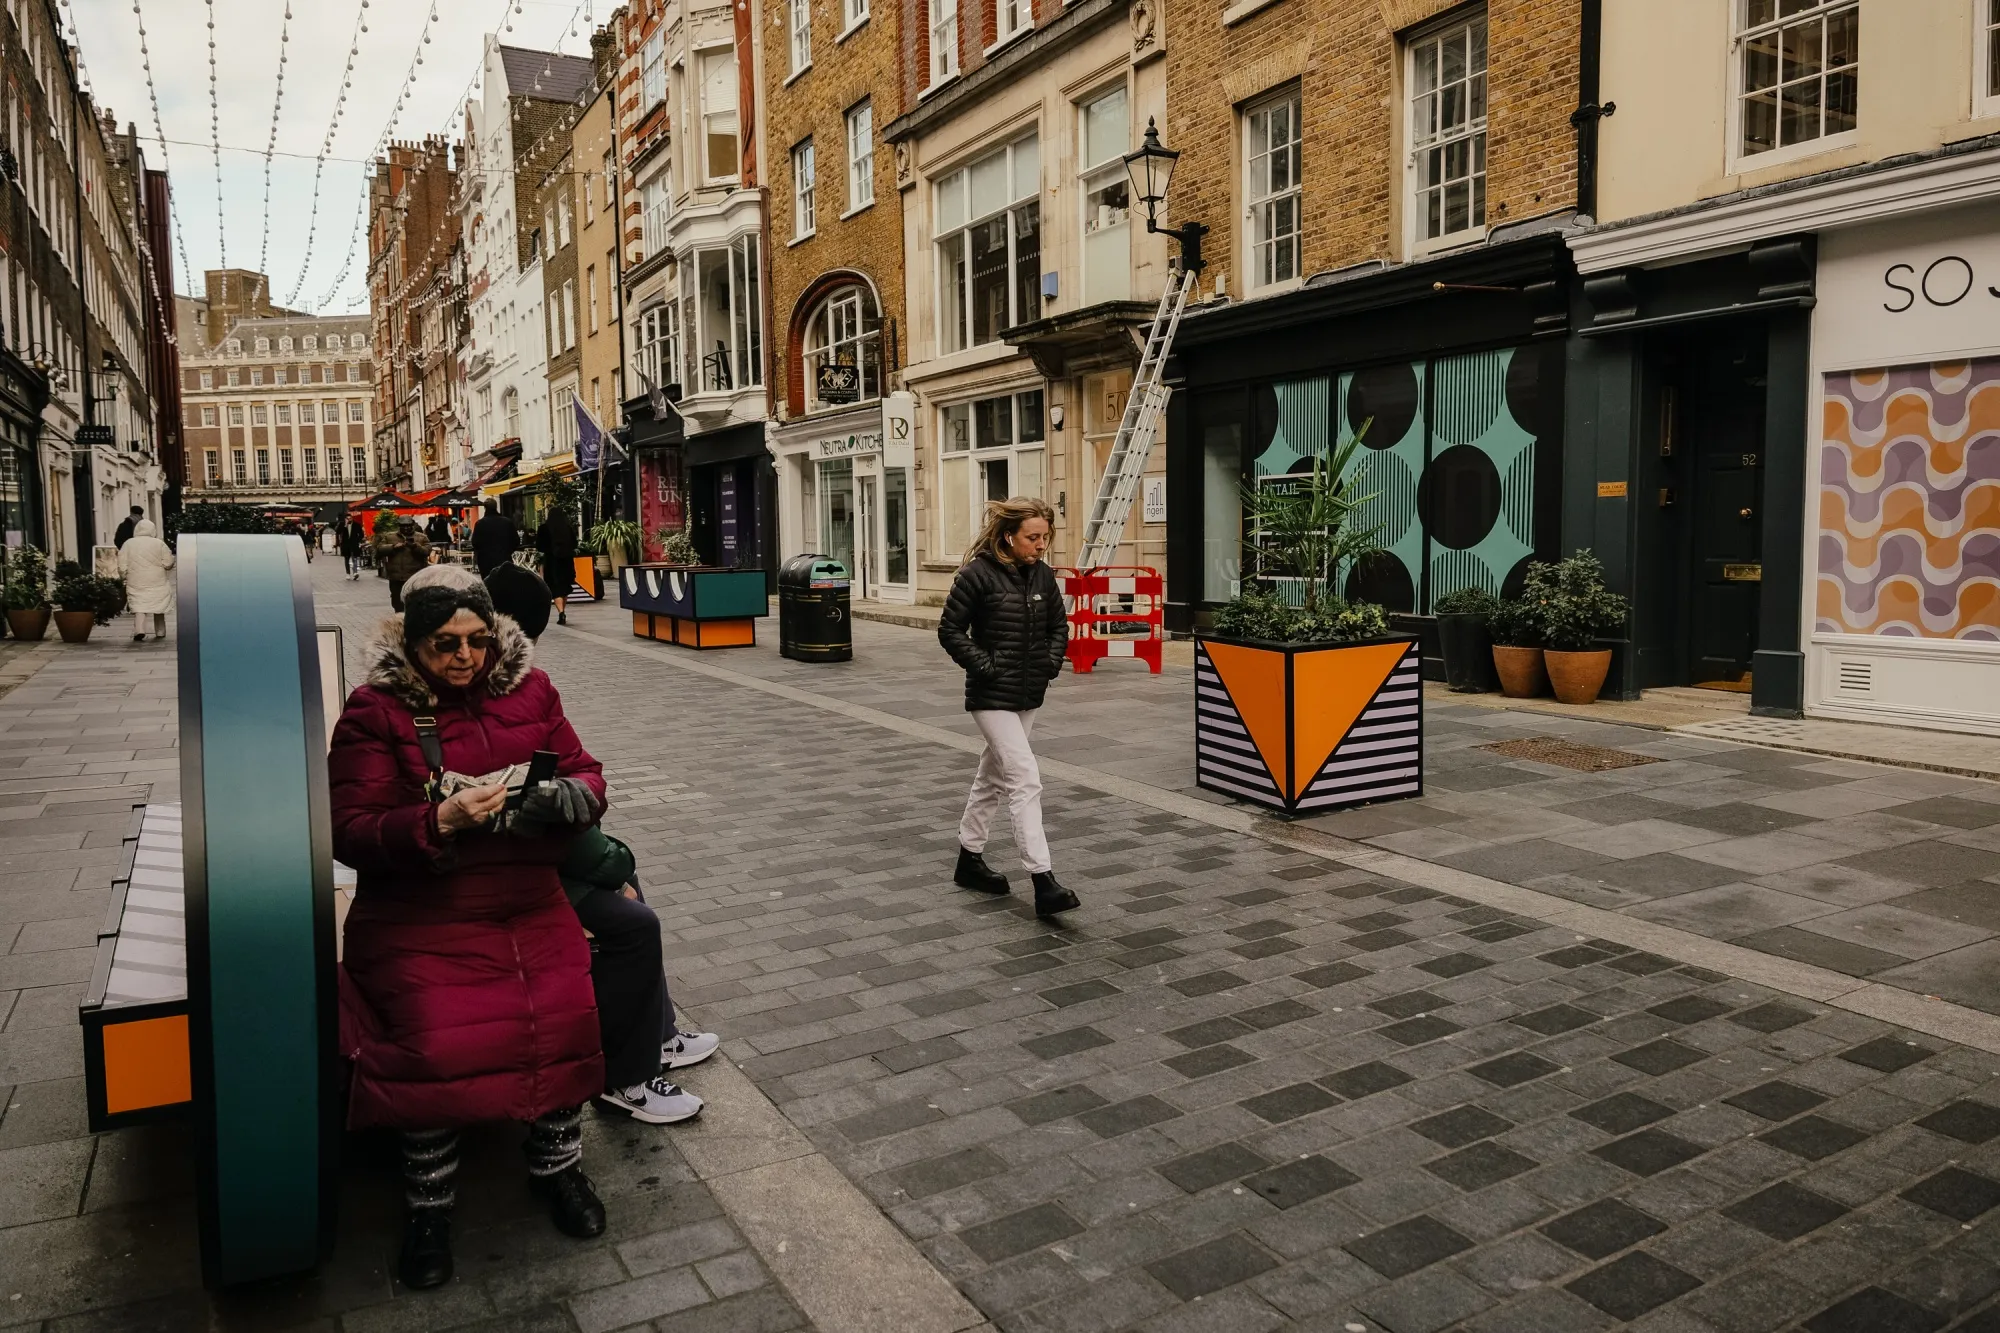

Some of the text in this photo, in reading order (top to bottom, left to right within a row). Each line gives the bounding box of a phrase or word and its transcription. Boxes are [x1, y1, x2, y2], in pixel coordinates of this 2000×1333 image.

[1107, 392, 1127, 421] 50
[820, 439, 847, 456] NEUTRA
[1742, 453, 1756, 466] 52
[1146, 507, 1164, 518] ngen
